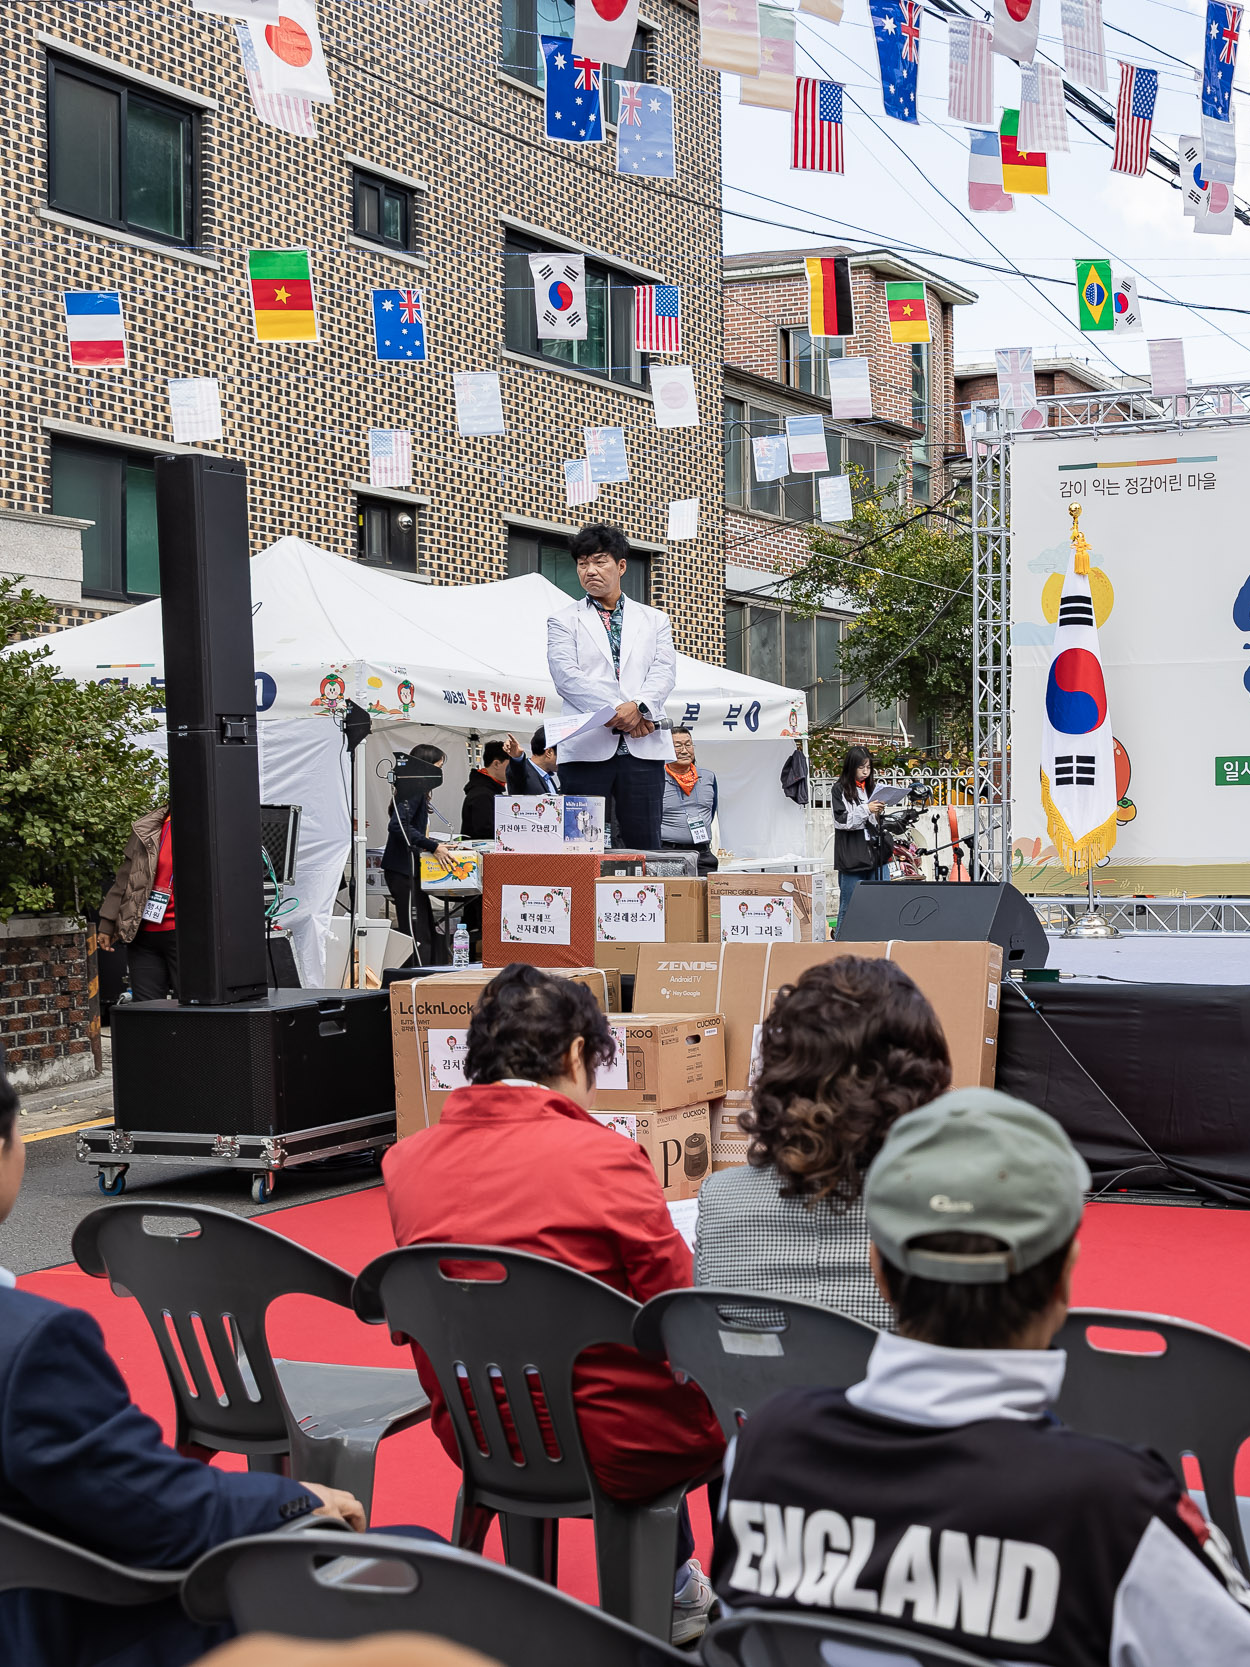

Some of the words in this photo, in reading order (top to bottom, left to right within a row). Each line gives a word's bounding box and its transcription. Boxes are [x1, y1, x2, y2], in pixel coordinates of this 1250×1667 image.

[1059, 479, 1087, 498] 감이
[1092, 478, 1121, 496] 익는
[1125, 474, 1182, 495] 정감어린
[1188, 472, 1217, 491] 마을
[442, 690, 467, 706] 제8회
[467, 688, 488, 712] 능동
[490, 691, 521, 715] 감마을
[524, 695, 546, 716] 축제
[500, 824, 527, 833] 키친아트
[148, 903, 162, 912] 행사
[144, 910, 160, 919] 지원
[604, 912, 656, 923] 물걸레청소기
[516, 924, 555, 935] 전자레인지
[731, 925, 749, 936] 전기
[754, 926, 783, 937] 그리들
[657, 961, 717, 971] ZENOS
[400, 1001, 474, 1014] LocknLock
[696, 1018, 721, 1029] CUCKOO
[682, 1108, 706, 1119] CUCKOO
[729, 1499, 1060, 1644] ENGLAND
